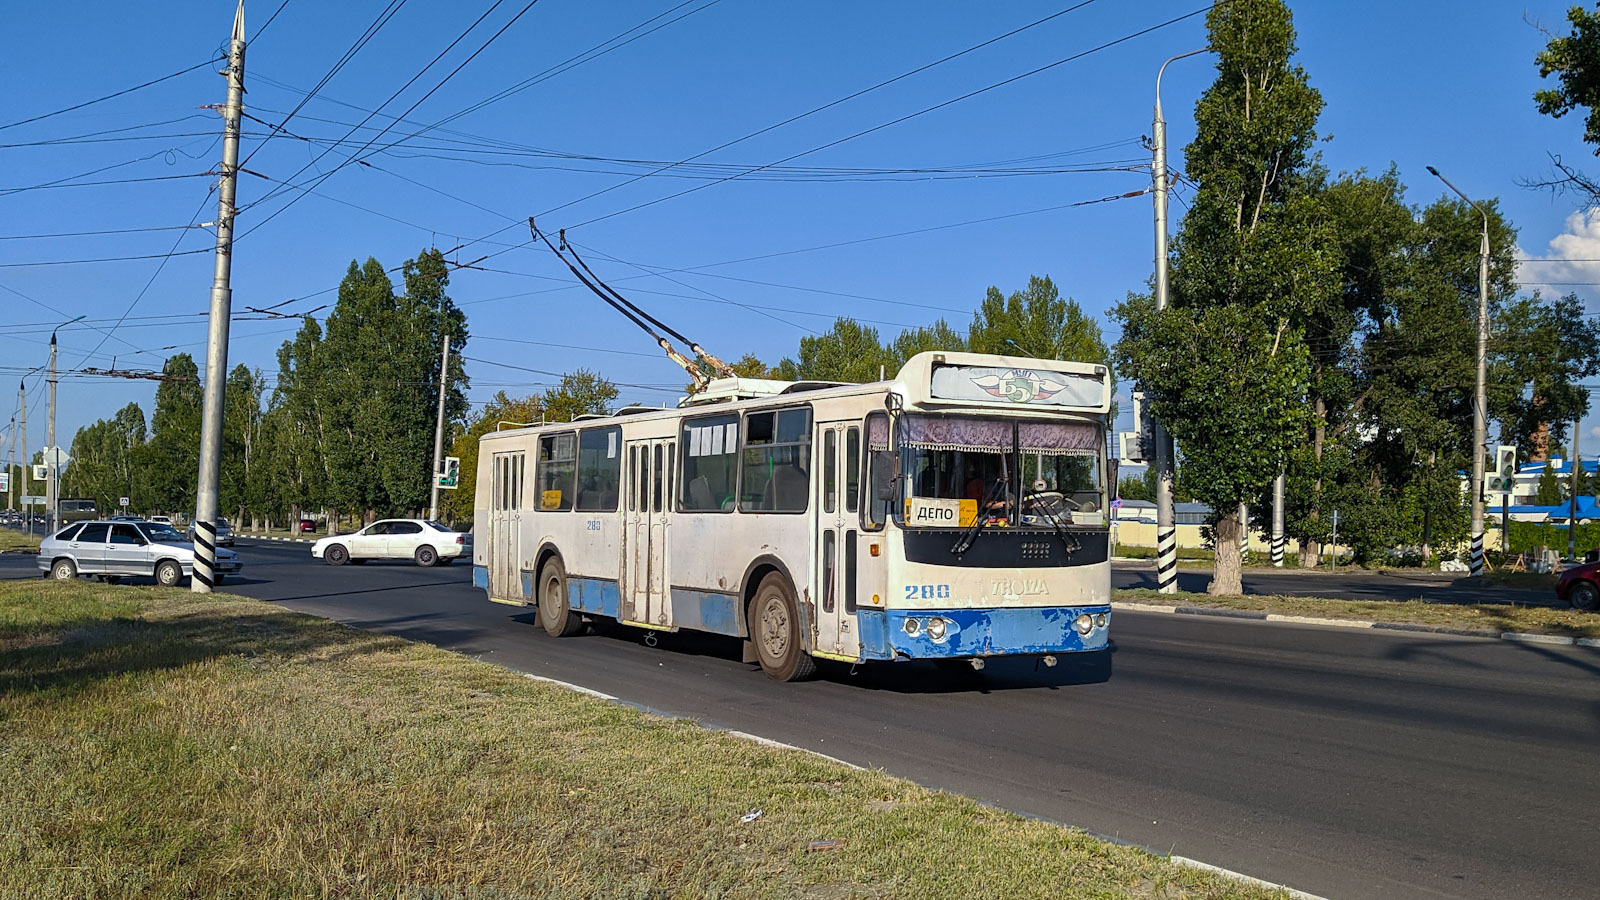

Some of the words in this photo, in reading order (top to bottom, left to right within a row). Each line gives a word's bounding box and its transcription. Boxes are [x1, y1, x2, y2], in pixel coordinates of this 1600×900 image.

[917, 506, 953, 521] ДЕПО
[905, 584, 950, 600] 280
[991, 579, 1050, 596] TROLZA
